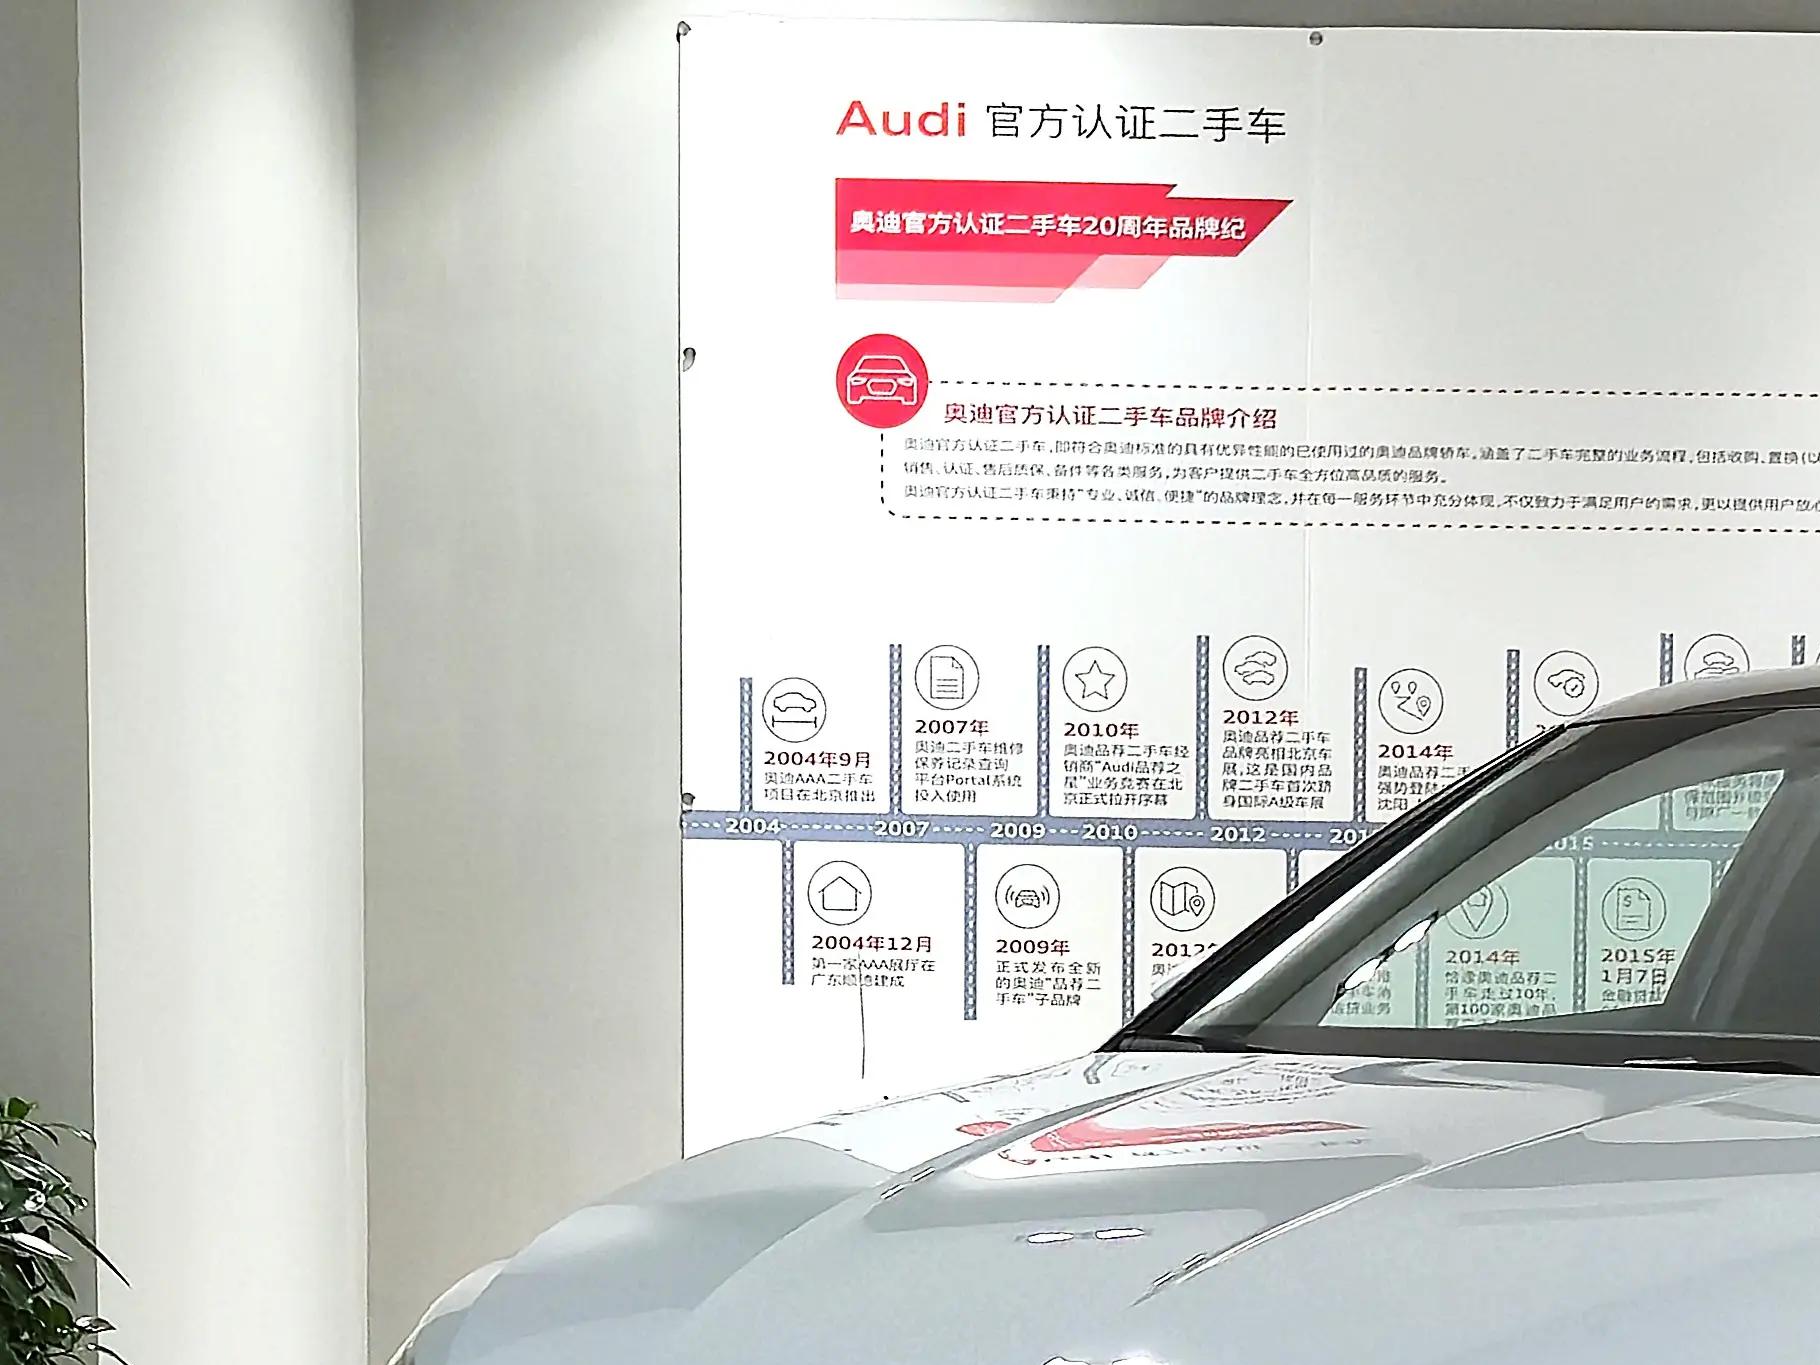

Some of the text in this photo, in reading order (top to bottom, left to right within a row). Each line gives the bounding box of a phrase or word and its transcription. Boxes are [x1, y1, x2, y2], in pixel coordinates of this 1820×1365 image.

[836, 101, 1287, 143] Audi 官方认证二手车
[850, 209, 1246, 241] 奥迪官方认证二手车20周年品牌纪
[943, 403, 1277, 430] 奥迪官方认证二手车品牌介绍
[1223, 710, 1299, 726] 2012年
[915, 720, 990, 736] 2007年
[1064, 723, 1140, 739] 2010年
[764, 751, 870, 768] 2004年9月
[1378, 745, 1454, 760] 2014年
[1377, 782, 1447, 795] 强势登陆
[725, 818, 780, 834] 2004
[874, 821, 930, 837] 2007
[990, 823, 1046, 839] 2009
[1082, 824, 1138, 841] 2010
[1210, 827, 1266, 842] 2012
[1330, 828, 1374, 844] 201
[812, 936, 931, 952] 2004年12月
[996, 940, 1071, 955] 2009年
[1151, 943, 1218, 958] 2012
[1445, 949, 1520, 965] 2014年
[1601, 948, 1676, 963] 2015年
[1601, 968, 1668, 984] 1月7日
